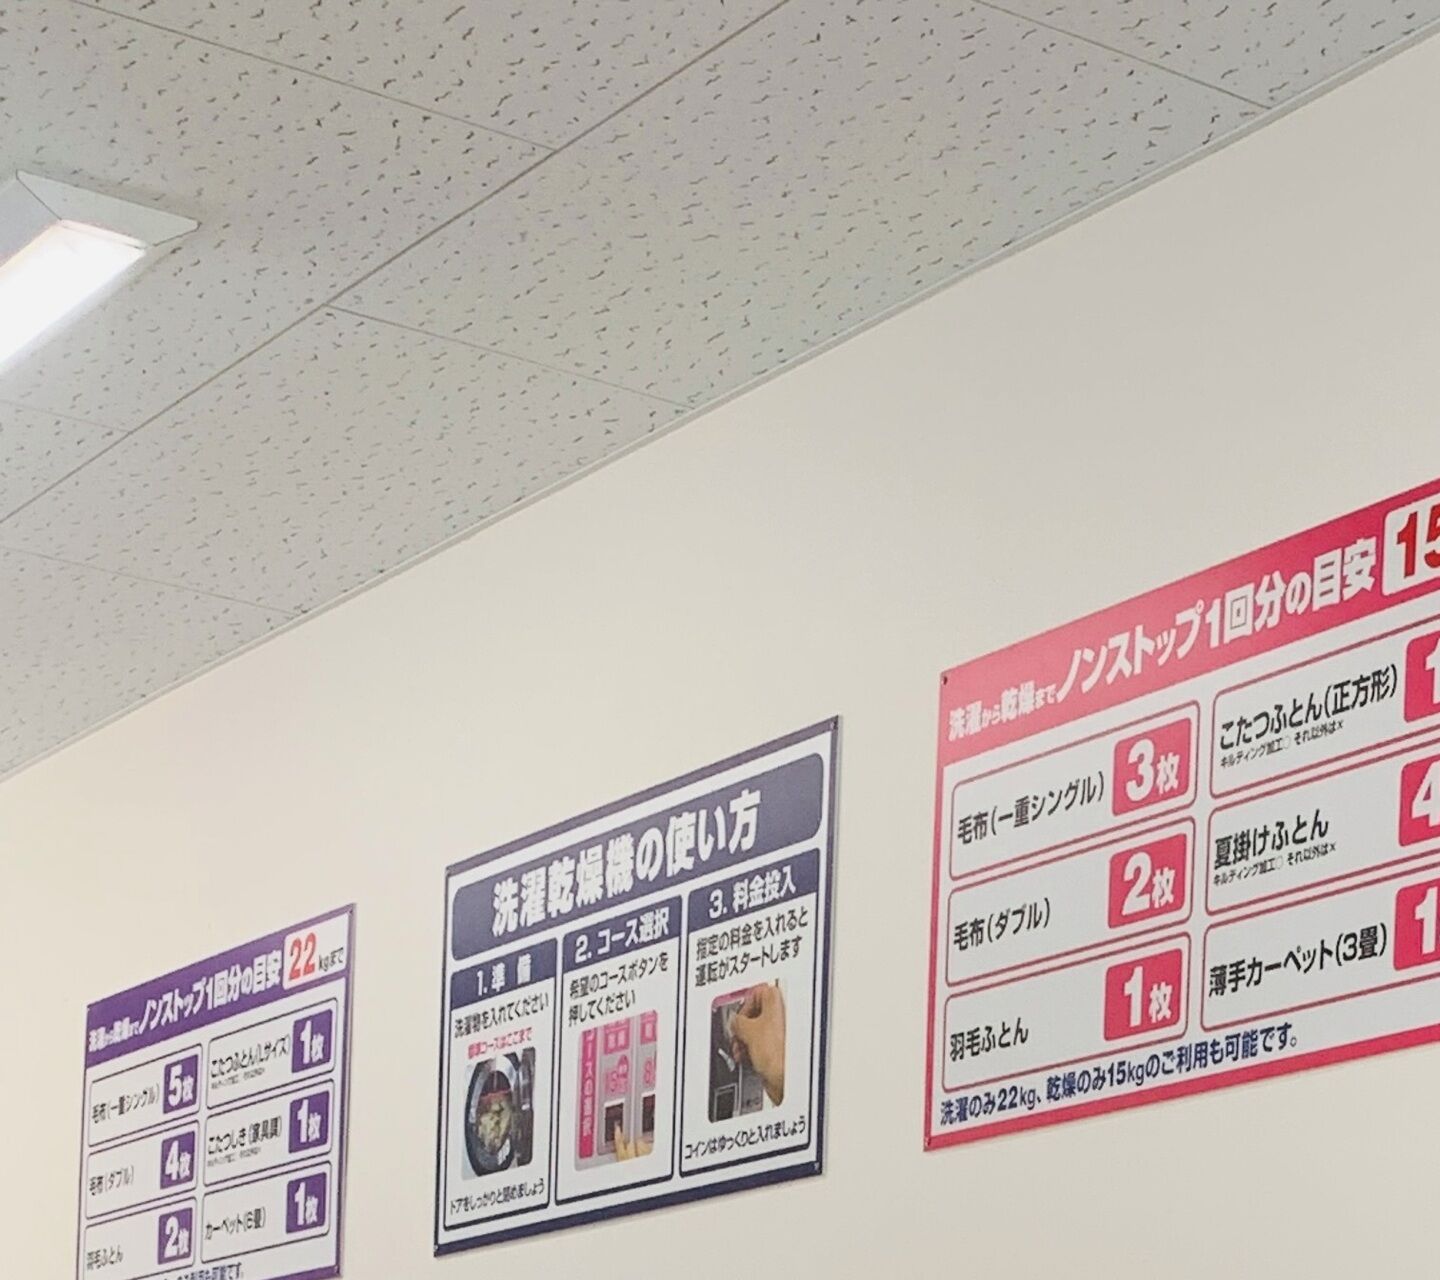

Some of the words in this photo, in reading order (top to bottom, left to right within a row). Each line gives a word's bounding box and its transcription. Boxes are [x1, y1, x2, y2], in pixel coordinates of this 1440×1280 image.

[1219, 664, 1398, 749] こたつふとん(正方形)
[1124, 738, 1179, 804] 3枚
[492, 790, 761, 936] 洗濯乾燥機の使い方
[1213, 811, 1329, 868] 夏掛けふとん
[1122, 852, 1175, 916] 2枚
[696, 906, 809, 960] 指定の料金を入れると
[570, 953, 669, 998] 希望のコースボタンを
[695, 938, 803, 989] 運転がスタートします
[1209, 925, 1388, 998] 薄手カーペット(3畳)
[454, 992, 550, 1039] 洗濯物を入れてください
[569, 992, 637, 1027] 押してください
[950, 1016, 1029, 1060] 羽毛ふとん
[1122, 967, 1172, 1027] 1枚
[301, 1021, 324, 1063] 1枚
[168, 1065, 194, 1107] 5枚
[298, 1099, 321, 1143] 1枚
[165, 1140, 191, 1181] 4枚
[294, 1183, 318, 1226] 1枚
[163, 1216, 189, 1258] 2枚
